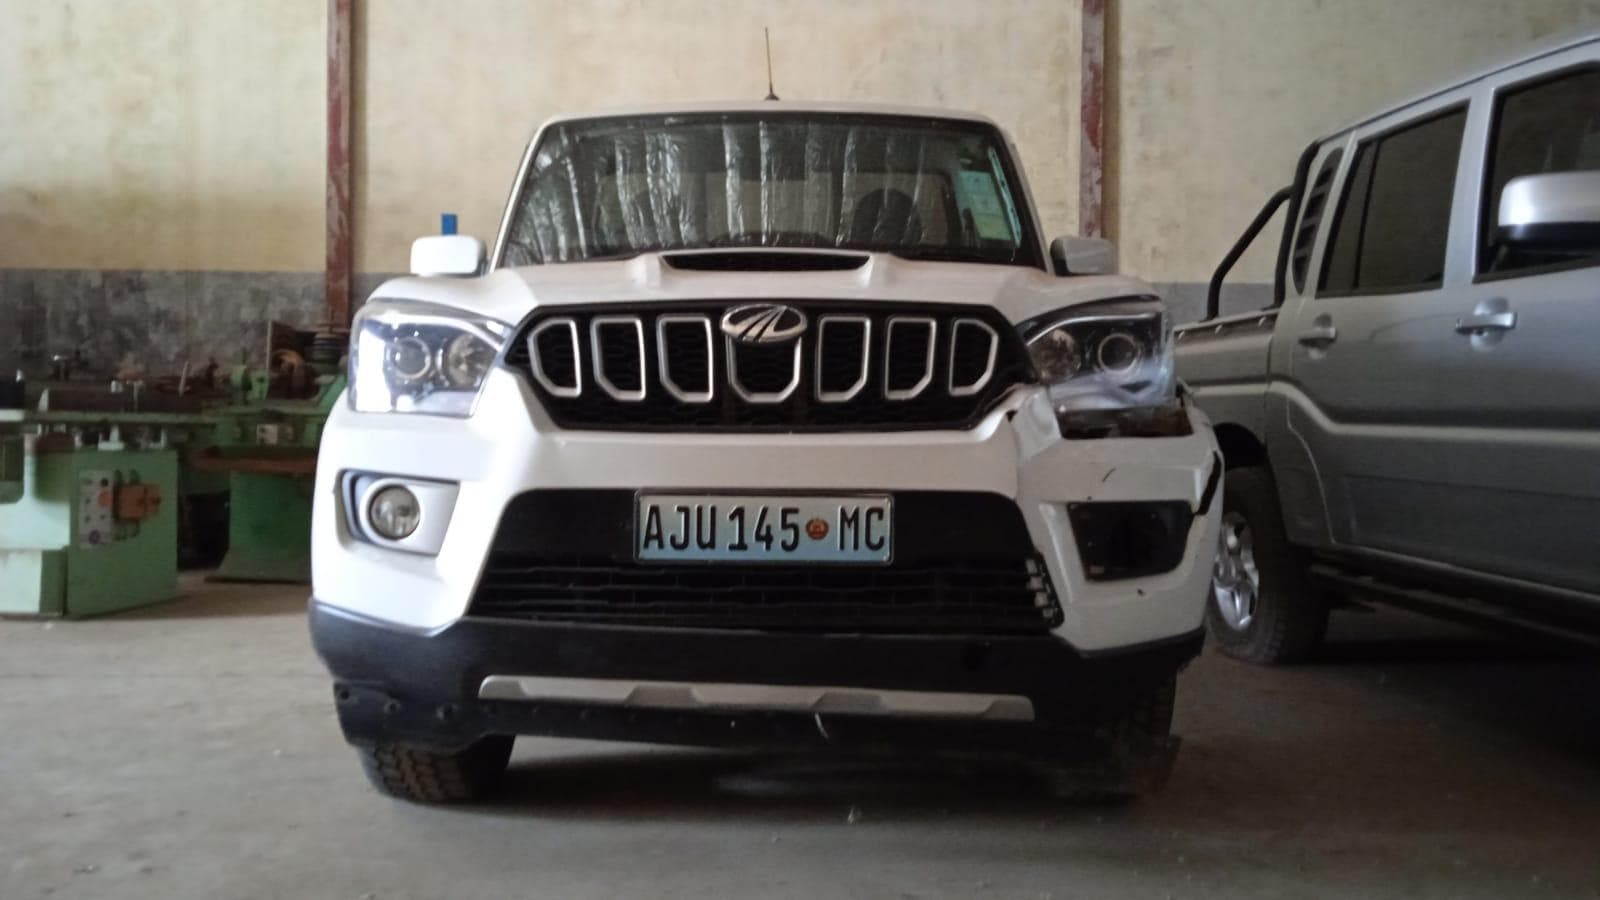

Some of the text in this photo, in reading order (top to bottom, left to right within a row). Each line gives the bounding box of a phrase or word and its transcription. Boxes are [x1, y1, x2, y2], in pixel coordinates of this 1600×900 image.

[643, 504, 885, 552] AJU 145 MC
